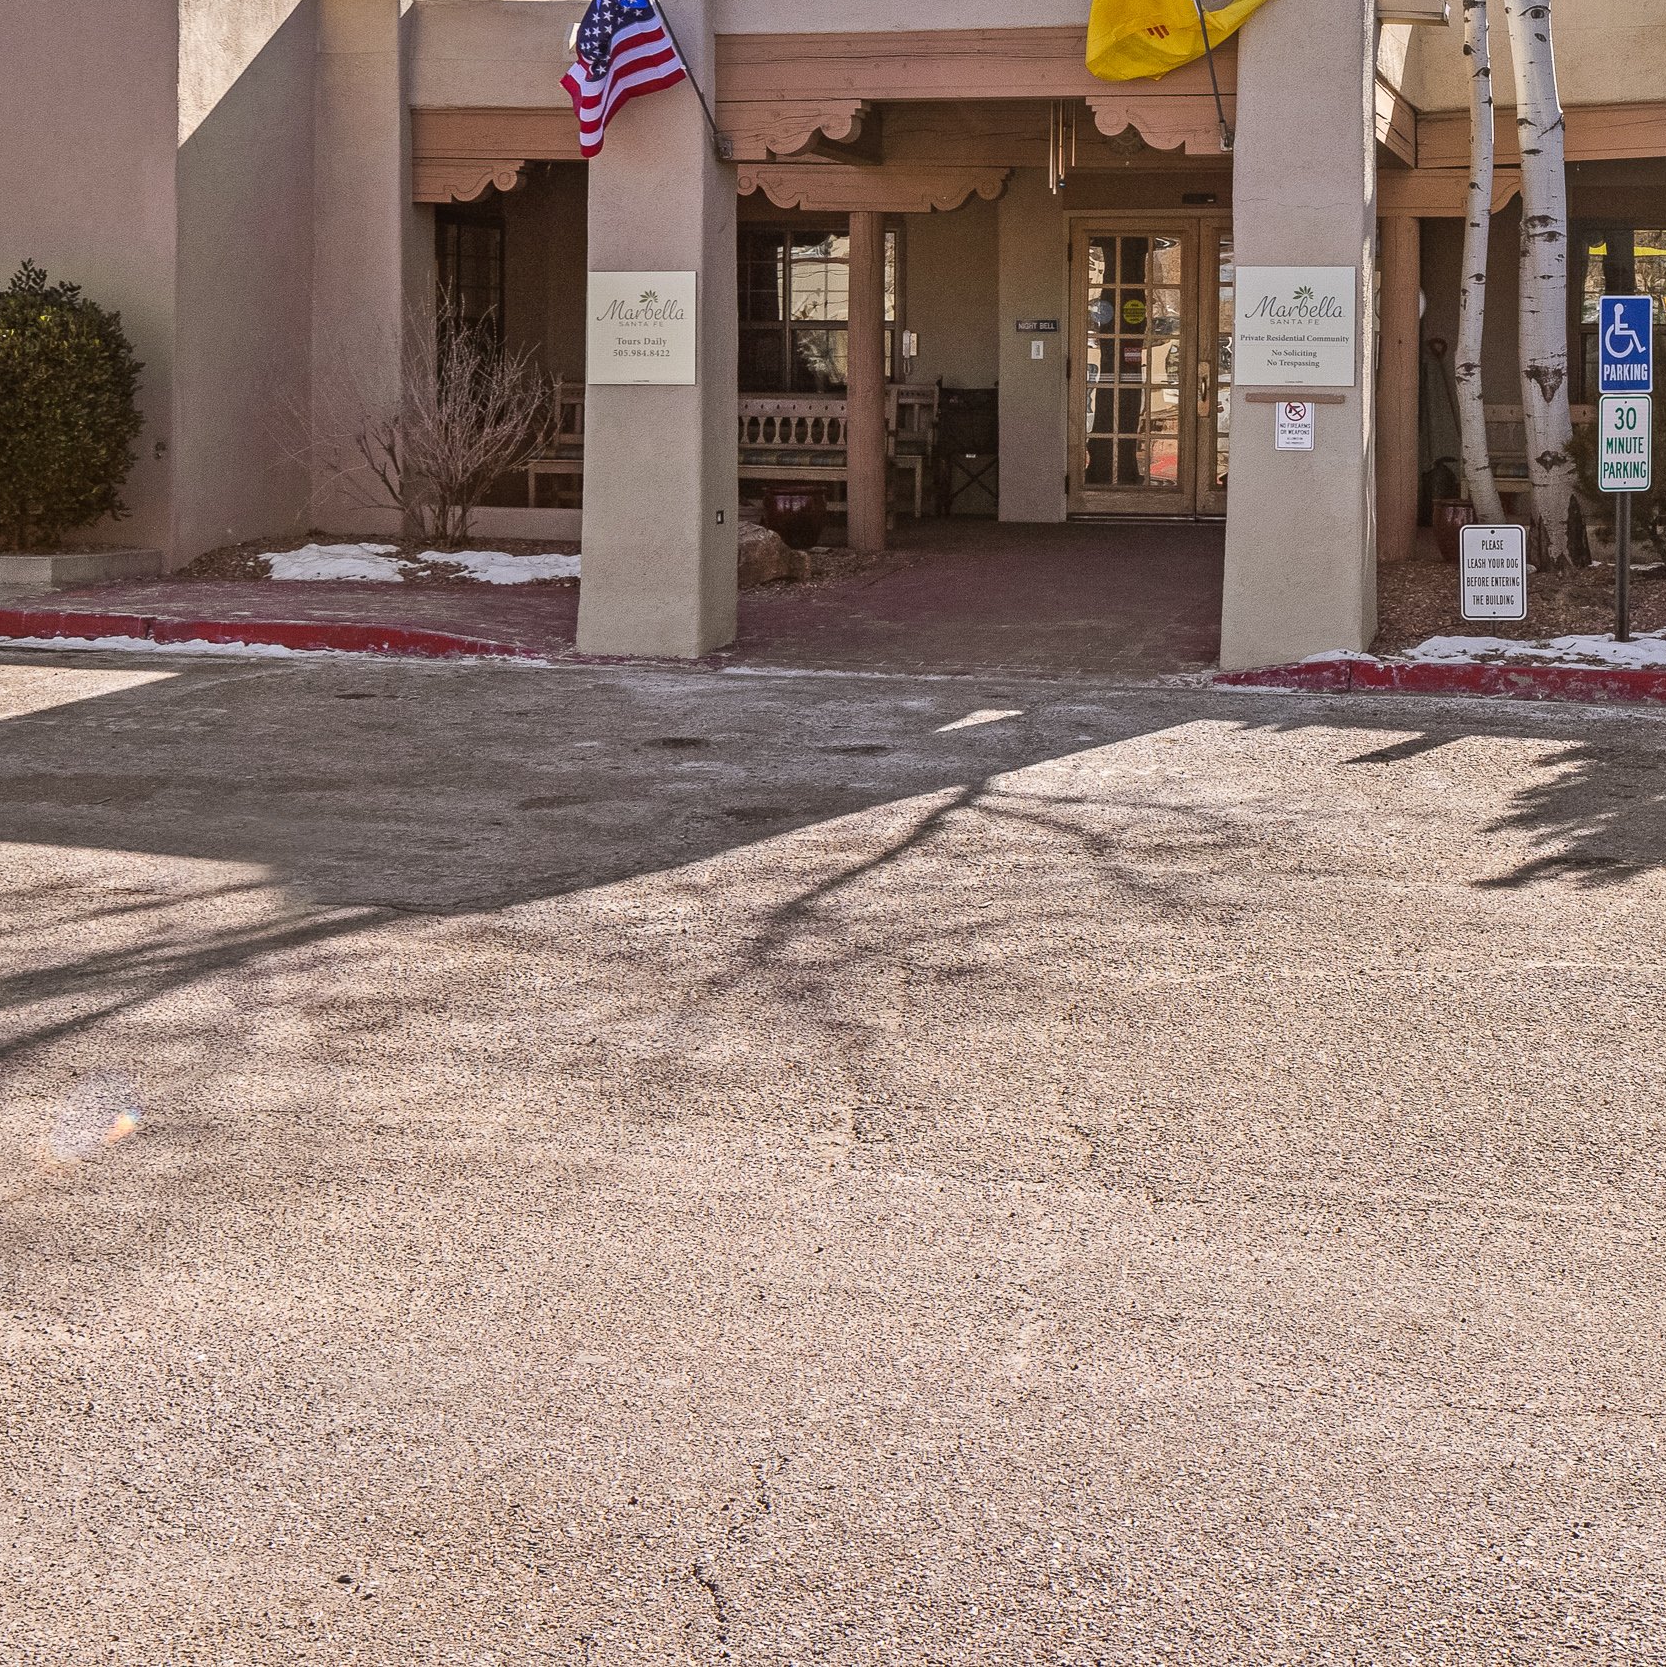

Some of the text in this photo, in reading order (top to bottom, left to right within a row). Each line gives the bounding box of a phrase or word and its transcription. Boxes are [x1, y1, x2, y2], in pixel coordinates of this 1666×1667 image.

[596, 299, 684, 321] Marbella
[1245, 295, 1342, 318] Marbella
[1018, 322, 1055, 330] NIGHT BELL
[644, 338, 667, 347] Daily
[1240, 334, 1349, 344] Private Residential Community
[613, 349, 670, 357] 505.984.8422
[1272, 349, 1317, 358] No Soliciting
[1279, 359, 1320, 368] Trespassing
[1603, 363, 1648, 381] PARKING
[1614, 407, 1637, 430] 30
[1606, 436, 1644, 454] MINUTE
[1603, 461, 1647, 479] PARKING
[1481, 540, 1504, 550] PLEASE
[1467, 558, 1519, 568] LEASH YOUR DOG
[1466, 577, 1520, 587] BEFORE ENTERING
[1473, 595, 1514, 605] THE BUILDING
